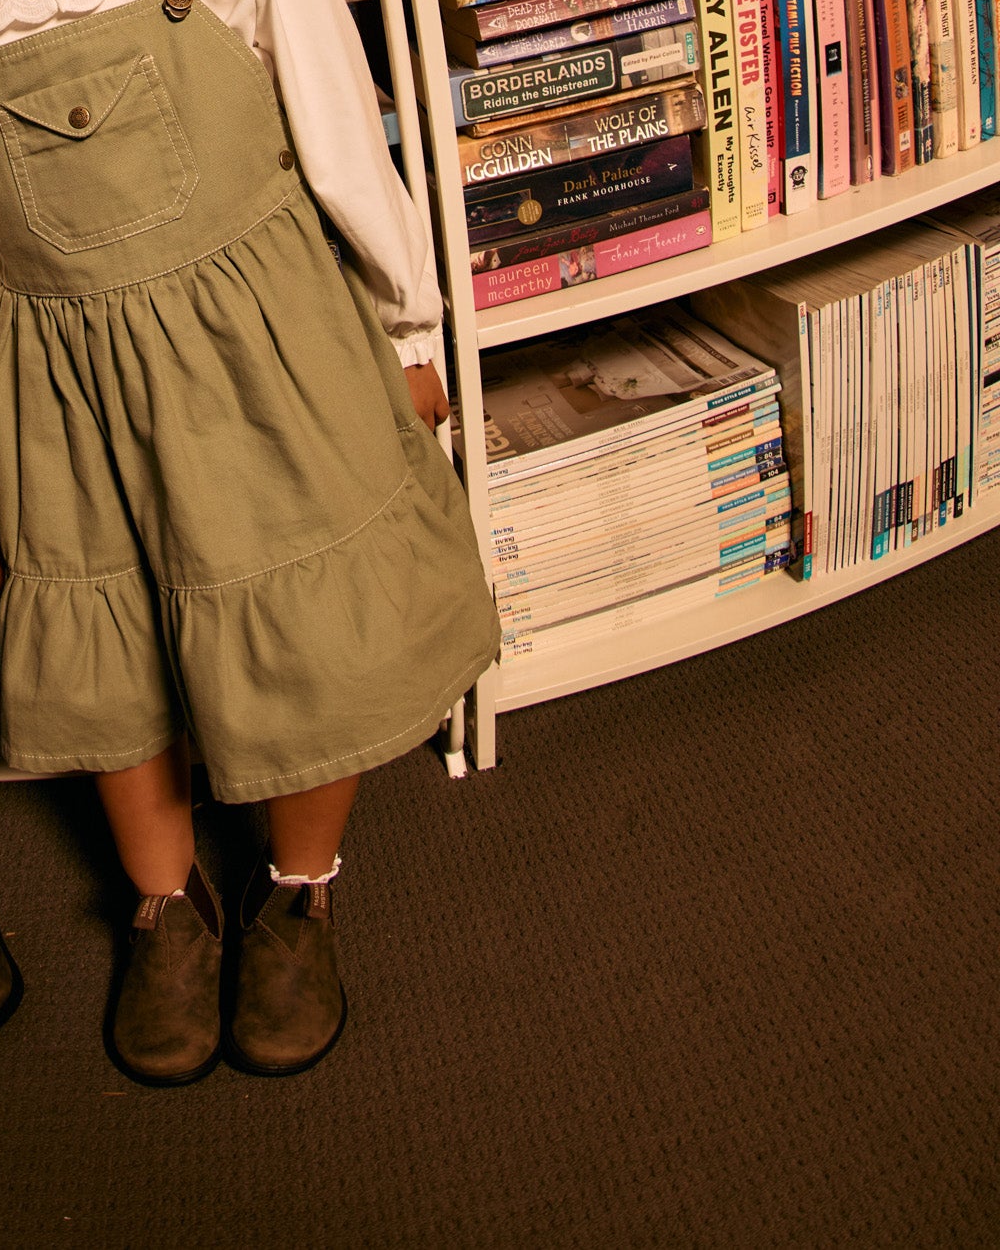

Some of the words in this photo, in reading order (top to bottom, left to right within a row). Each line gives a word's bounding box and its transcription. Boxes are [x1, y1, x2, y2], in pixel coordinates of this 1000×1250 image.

[738, 9, 761, 86] FOSTER
[470, 55, 607, 99] BORDERLANDS
[483, 95, 519, 110] Riding
[522, 90, 539, 102] the
[542, 76, 598, 99] Slipstream
[708, 30, 733, 132] ALLEN
[588, 136, 617, 153] THE
[619, 119, 669, 146] PLAINS
[594, 111, 637, 133] WOLF
[639, 105, 657, 122] OF
[480, 135, 533, 159] CONN
[465, 148, 553, 183] IGGULDEN
[563, 176, 597, 194] Dark
[602, 164, 643, 183] Palace
[557, 192, 588, 207] FRANK
[592, 176, 651, 198] MOORHOUSE
[488, 262, 549, 287] maureen
